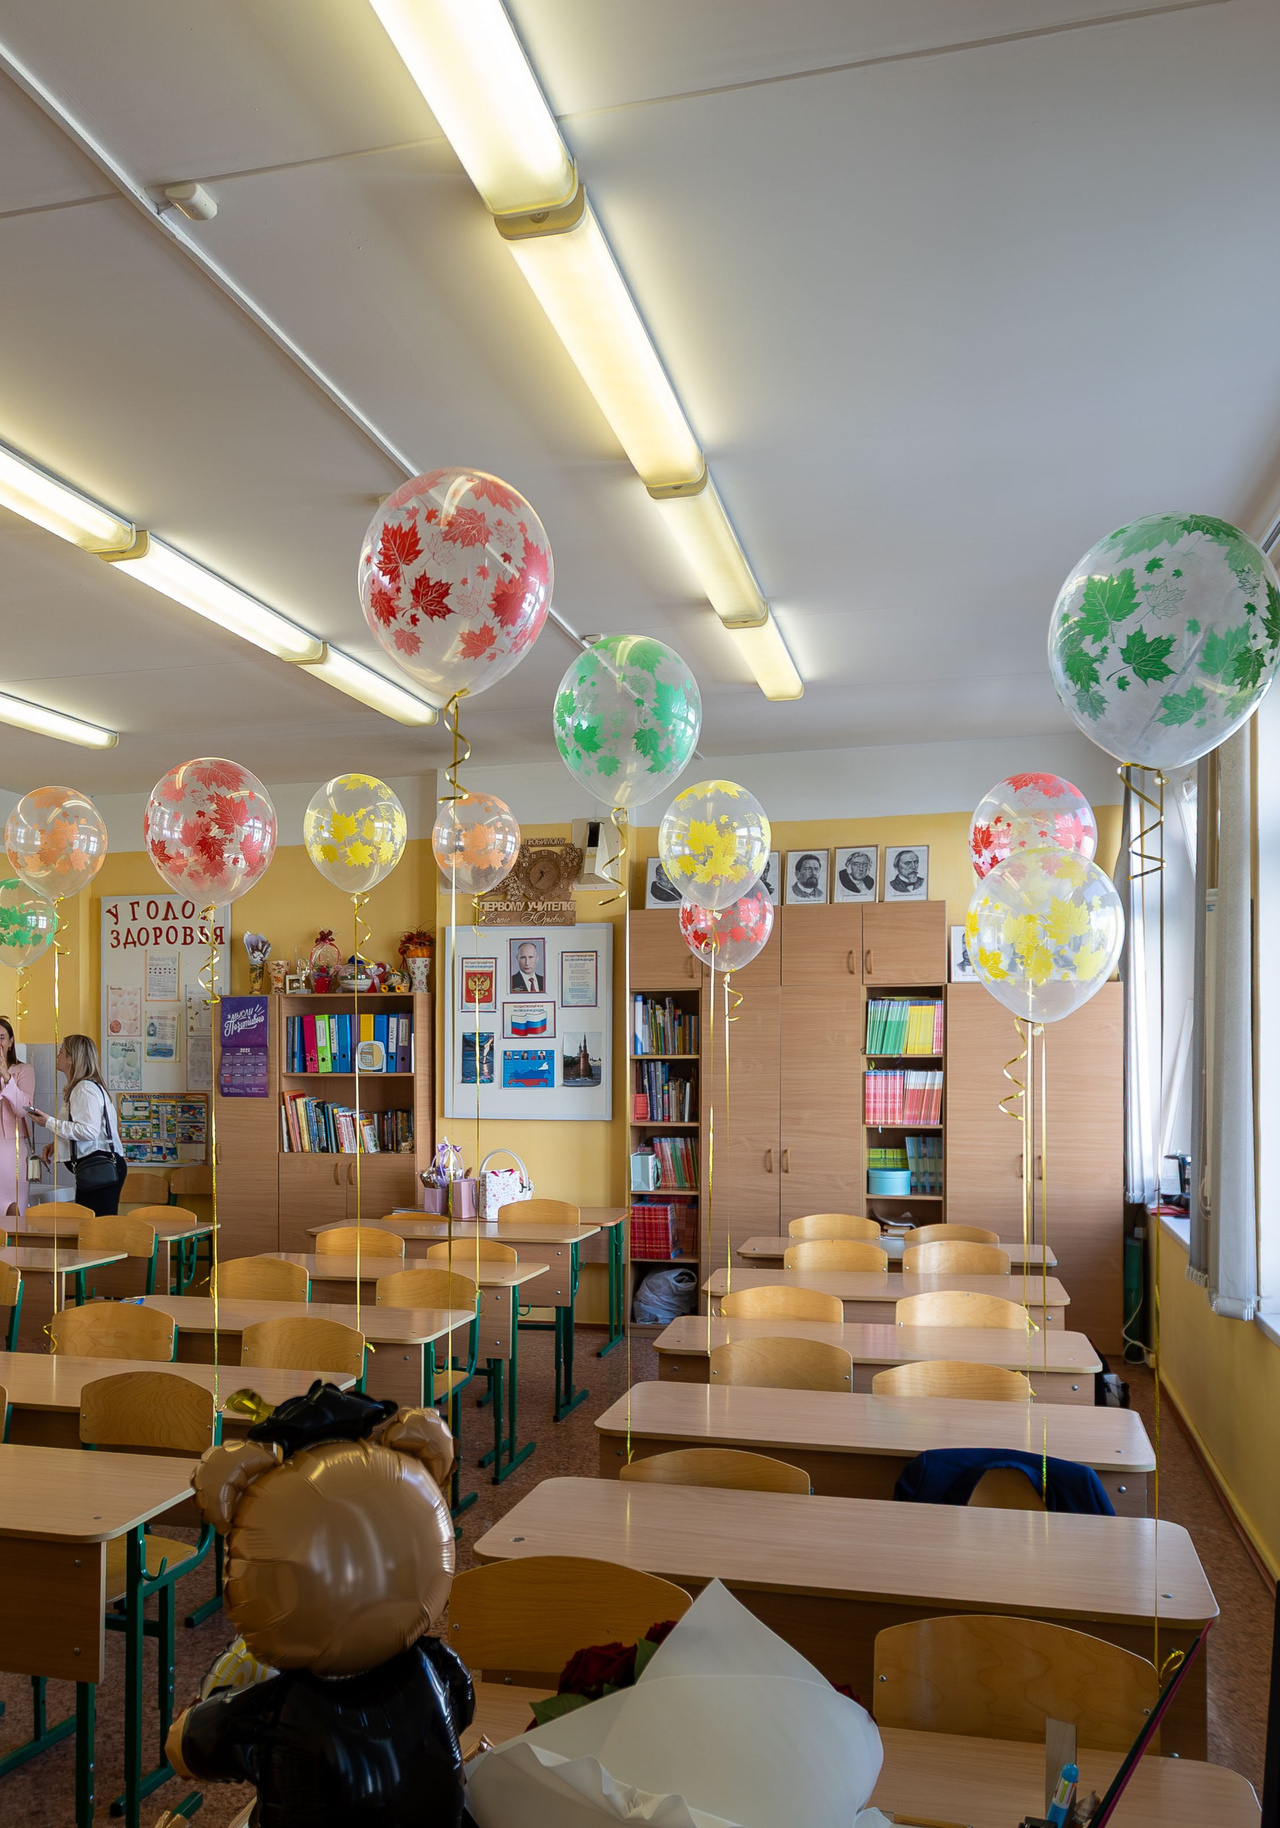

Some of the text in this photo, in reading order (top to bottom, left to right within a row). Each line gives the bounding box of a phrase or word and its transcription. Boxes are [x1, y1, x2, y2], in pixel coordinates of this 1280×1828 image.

[105, 900, 216, 925] УГОЛО
[480, 901, 577, 911] ПЕРВОМУ УЧИТЕЛЮ
[110, 925, 225, 949] ЗДОРОВЬЯ
